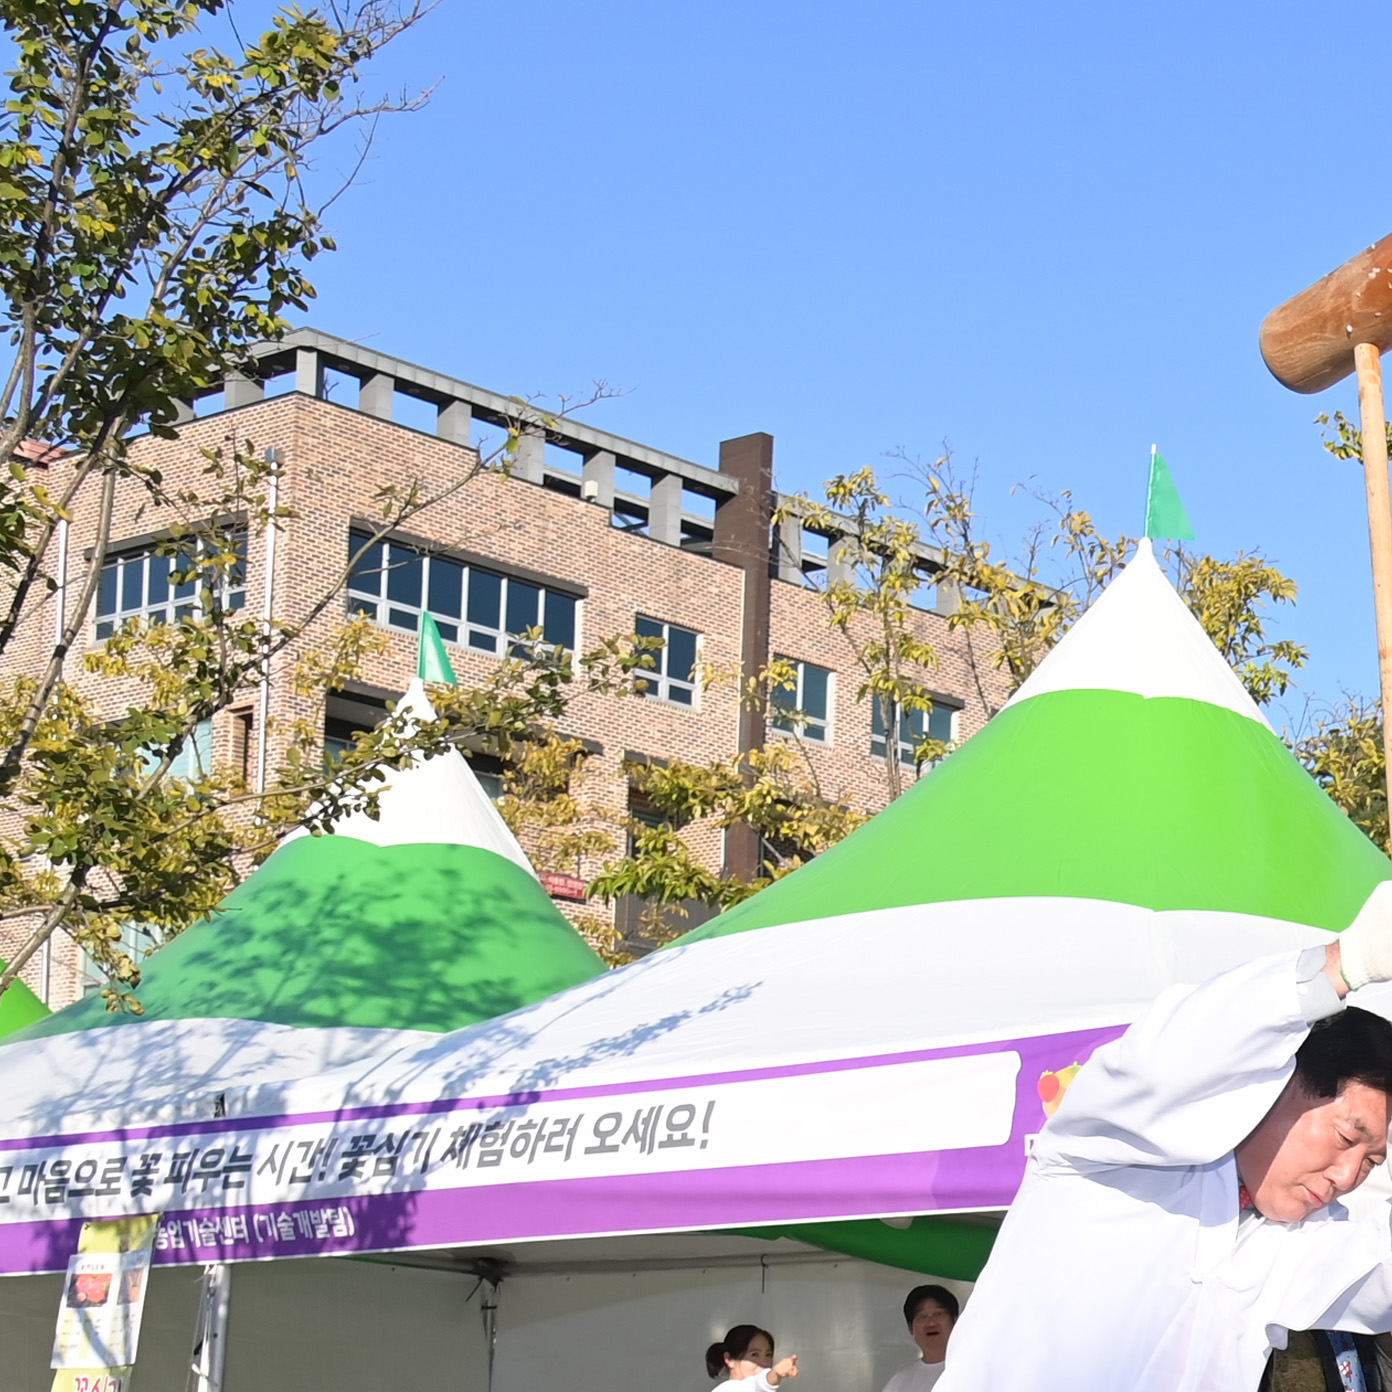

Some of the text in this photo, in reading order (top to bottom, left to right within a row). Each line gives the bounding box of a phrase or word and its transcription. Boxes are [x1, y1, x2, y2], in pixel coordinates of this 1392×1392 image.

[18, 1156, 126, 1205] 마음으로
[130, 1153, 163, 1198] 꽃
[163, 1145, 253, 1195] 피우는
[257, 1137, 339, 1187] 시간!
[338, 1128, 440, 1182] 꽃심기
[440, 1113, 585, 1170] 체험하러
[583, 1100, 717, 1156] 오세요!
[253, 1204, 357, 1243] (기술개발팀)
